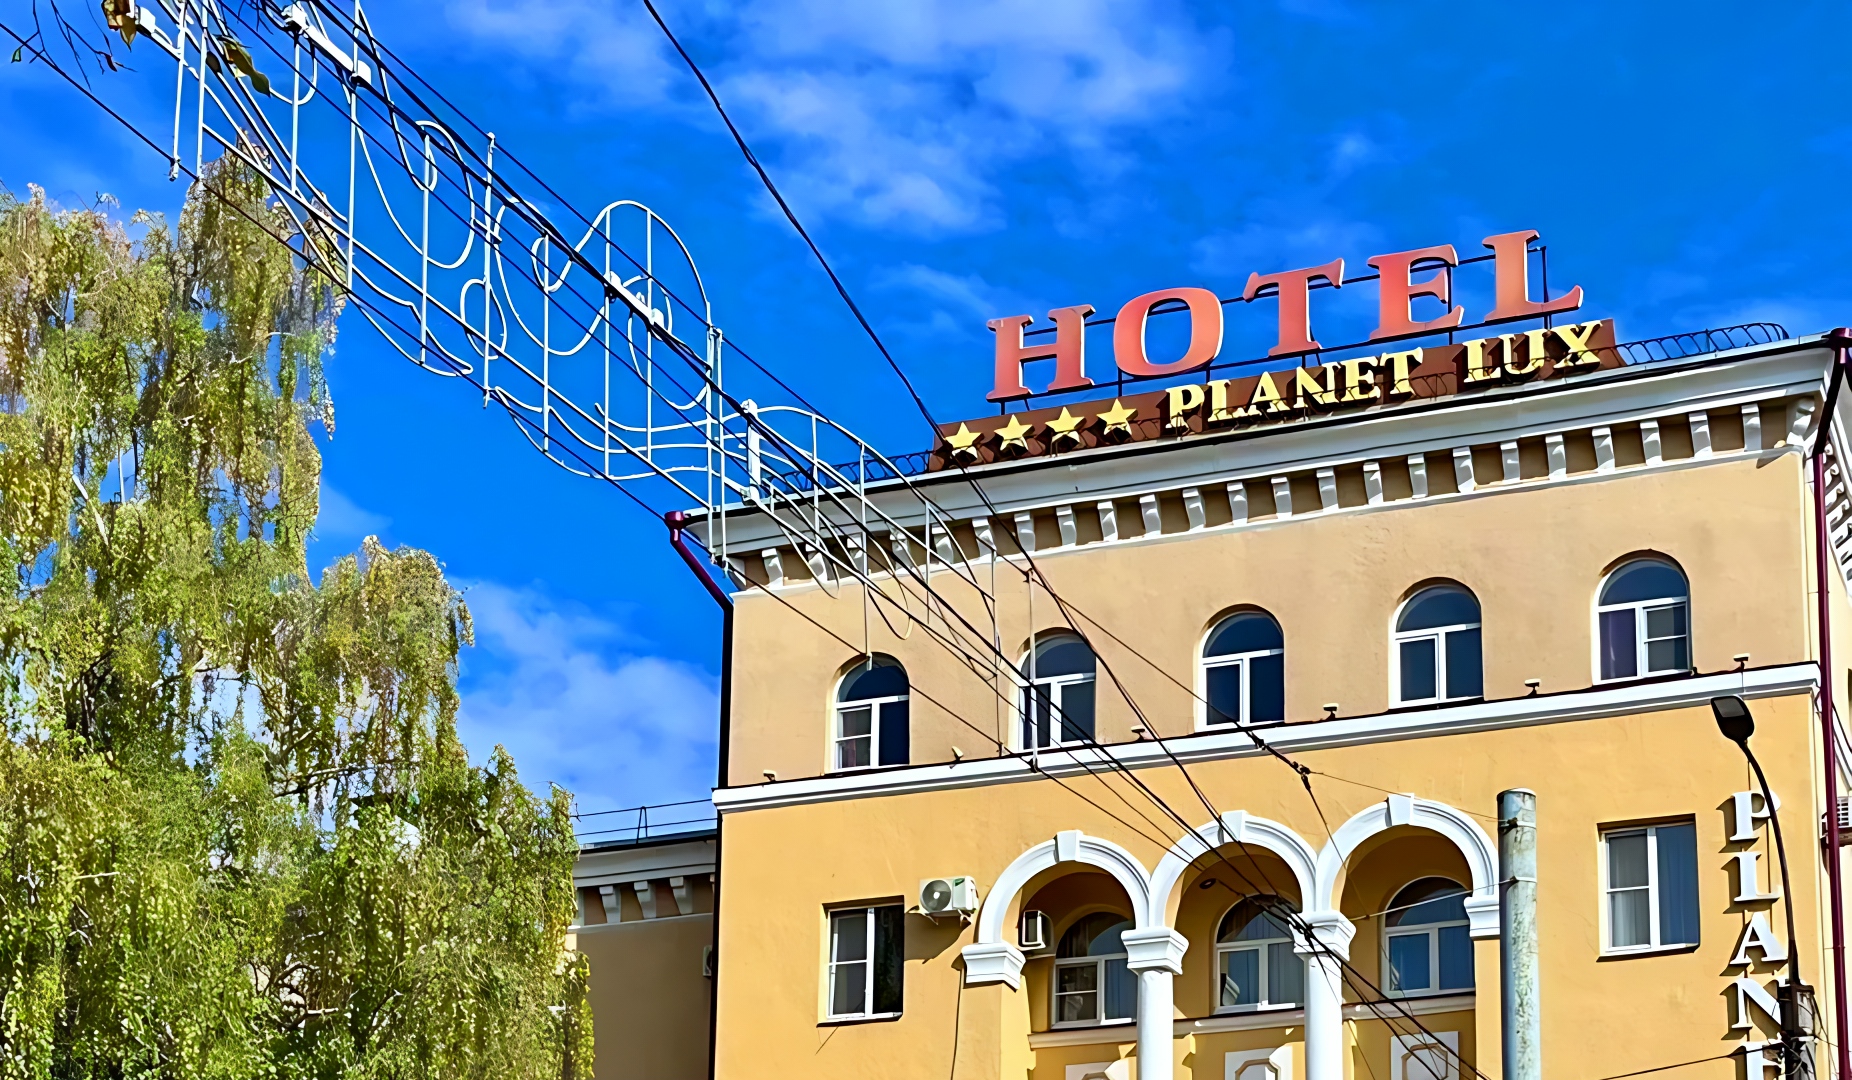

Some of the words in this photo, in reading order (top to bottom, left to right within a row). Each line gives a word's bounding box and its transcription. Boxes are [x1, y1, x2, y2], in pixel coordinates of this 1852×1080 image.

[986, 229, 1584, 401] HOTEL
[1165, 346, 1424, 430] PLANET
[1462, 319, 1603, 384] LUX
